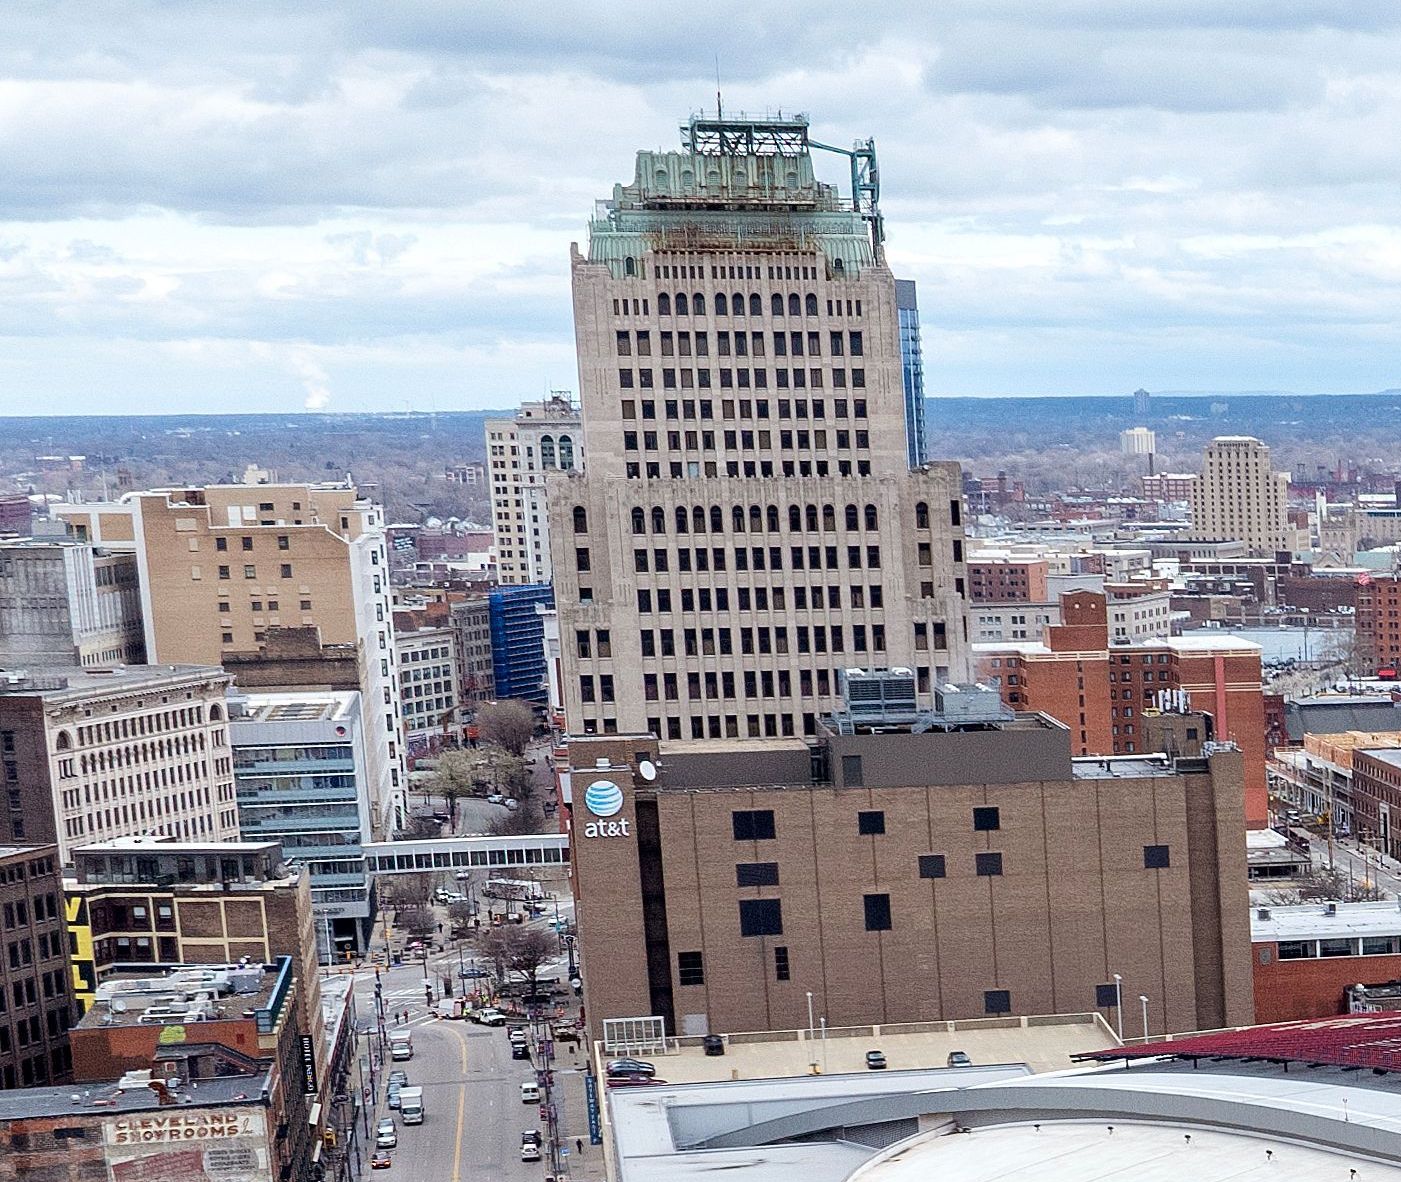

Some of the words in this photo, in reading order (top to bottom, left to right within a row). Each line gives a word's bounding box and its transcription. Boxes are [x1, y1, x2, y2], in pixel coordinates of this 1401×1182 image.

[584, 817, 630, 838] at&t
[115, 1114, 239, 1131] CLEVELAND
[115, 1125, 239, 1144] SHOWROOMS
